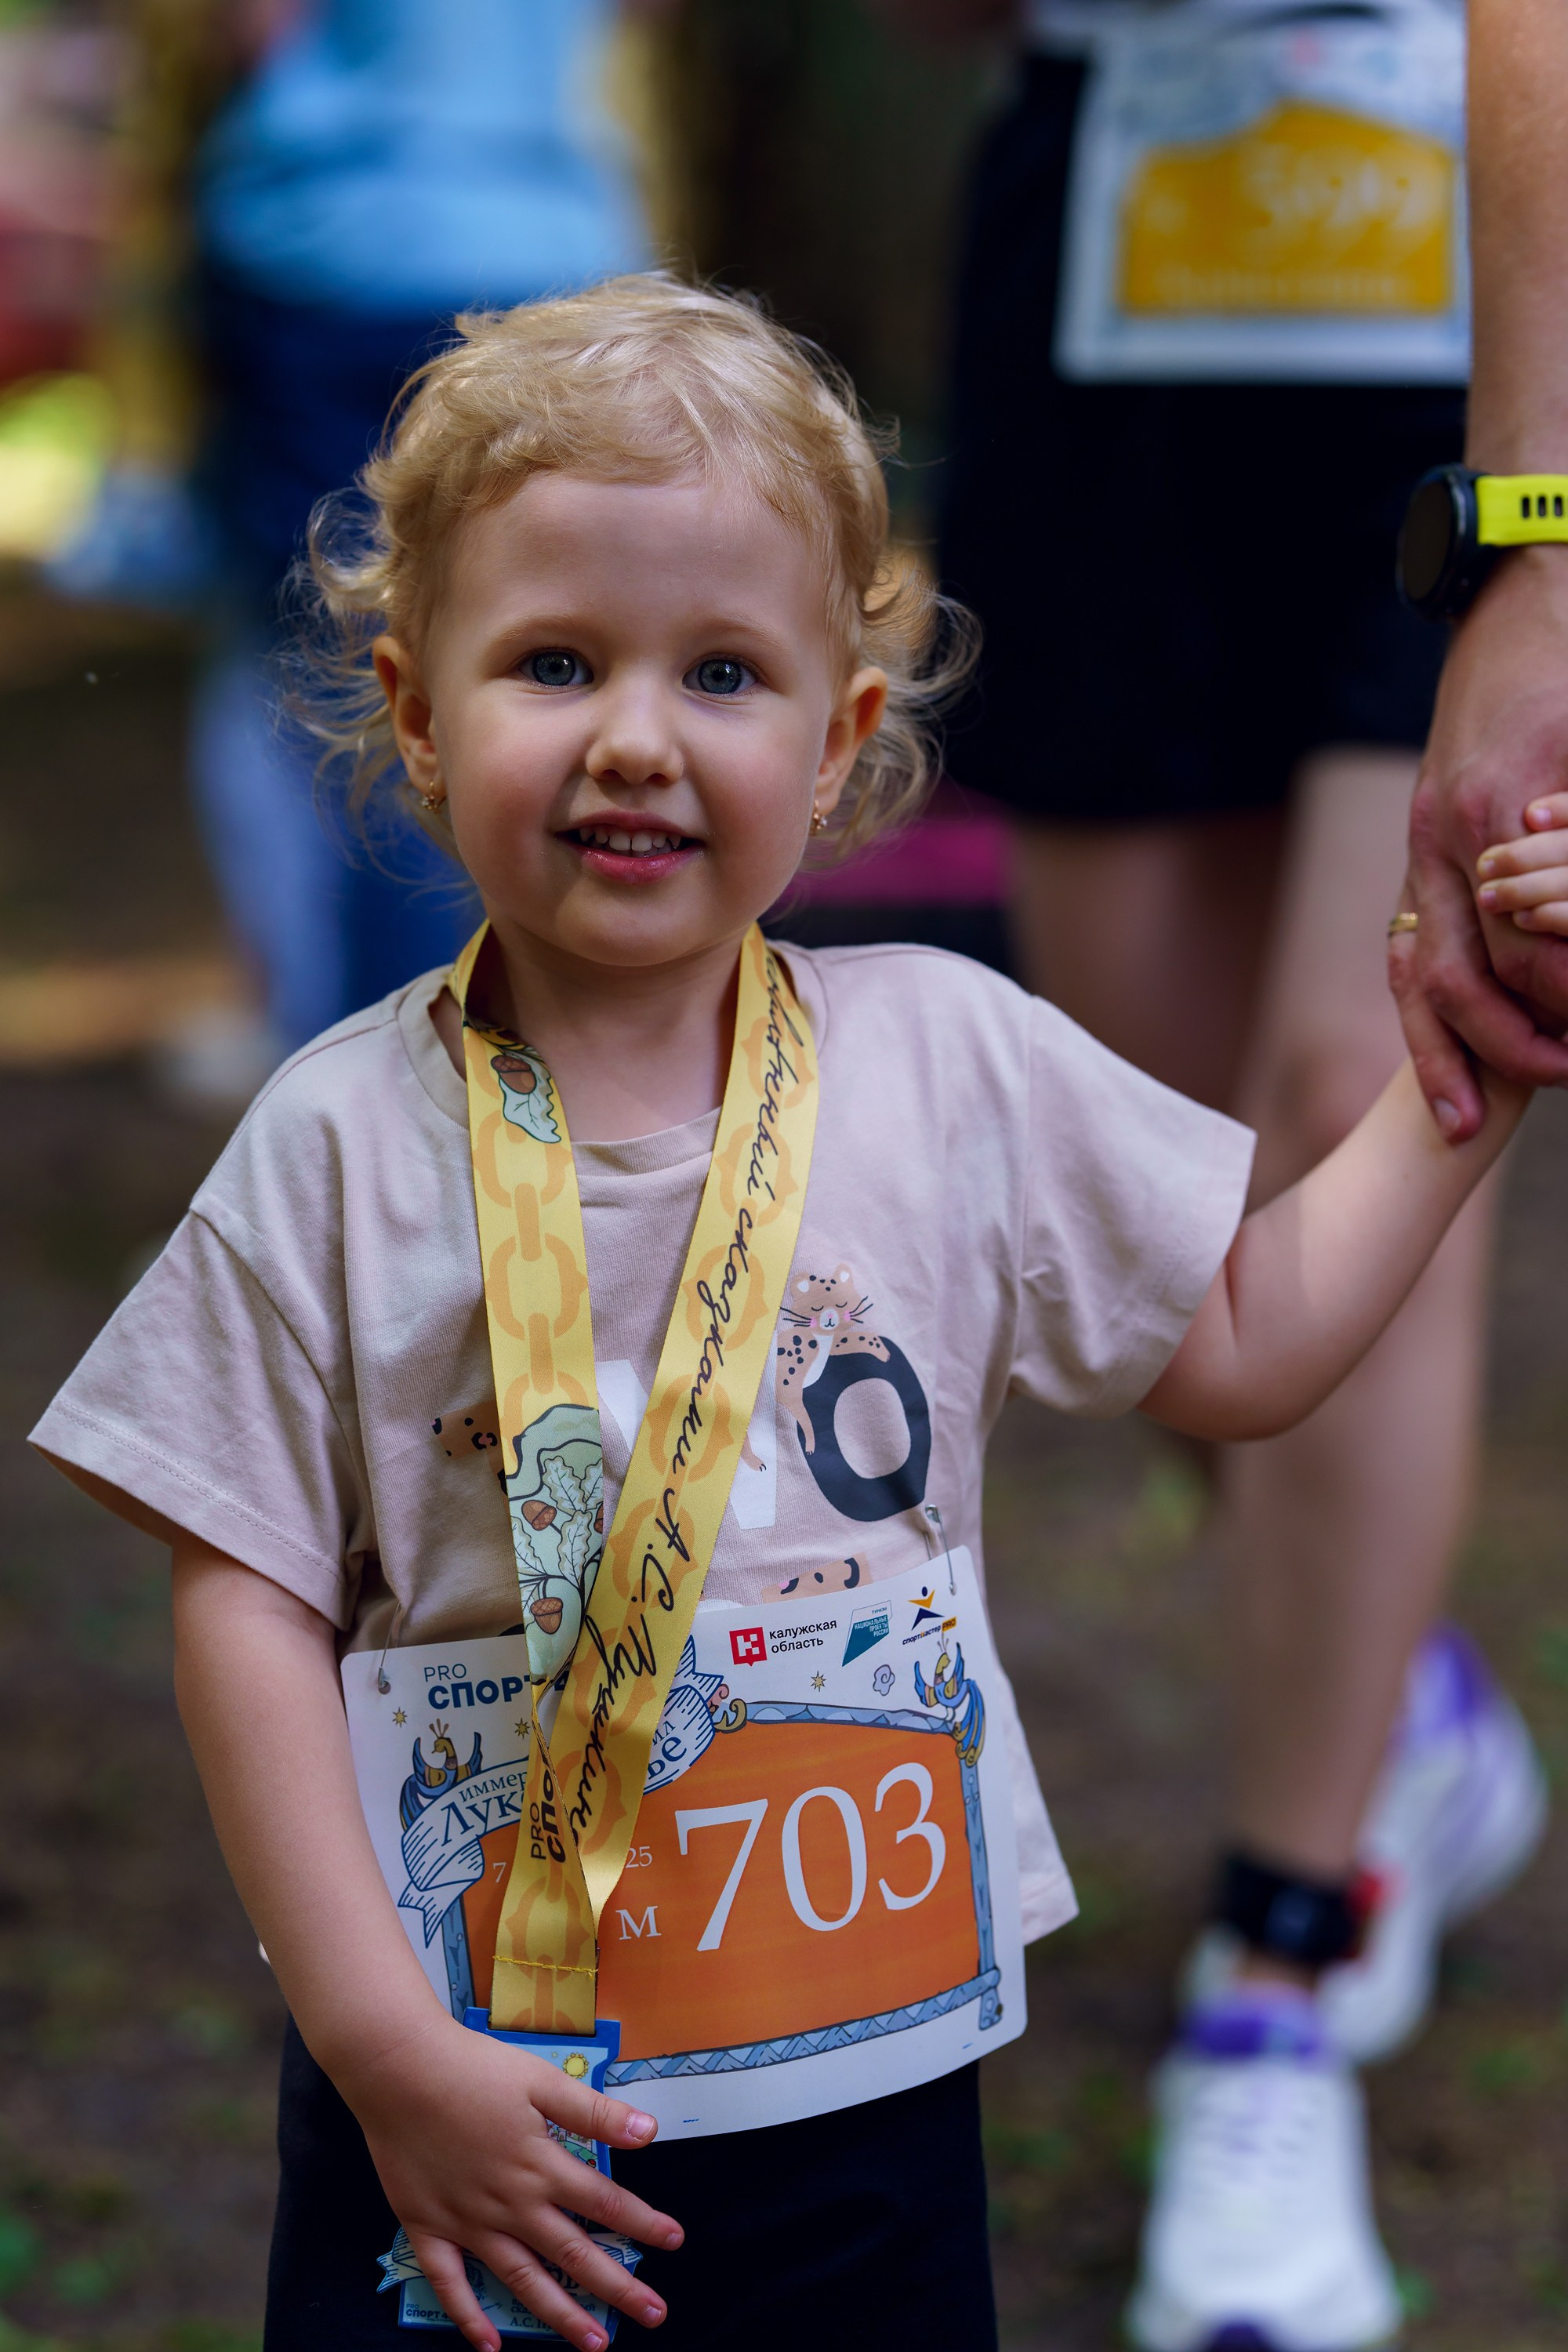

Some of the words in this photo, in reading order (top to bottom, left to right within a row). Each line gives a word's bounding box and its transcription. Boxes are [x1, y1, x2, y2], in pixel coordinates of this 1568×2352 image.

[872, 1606, 887, 1615] ТУРИЗМ
[769, 1620, 837, 1640] калужская
[854, 1616, 887, 1630] НАЦИОНАЛЬНЫЕ
[869, 1622, 888, 1632] ПРОЕКТЫ
[873, 1628, 889, 1637] РОССИИ
[902, 1625, 942, 1646] спортмастер
[771, 1637, 824, 1654] область
[423, 1663, 467, 1682] PRO
[570, 1612, 657, 1847] Пушкин
[530, 1802, 547, 1860] PRO
[626, 1846, 652, 1868] 25
[674, 1762, 947, 1952] 703
[492, 1861, 507, 1883] 7
[405, 2309, 441, 2318] СПОРТ
